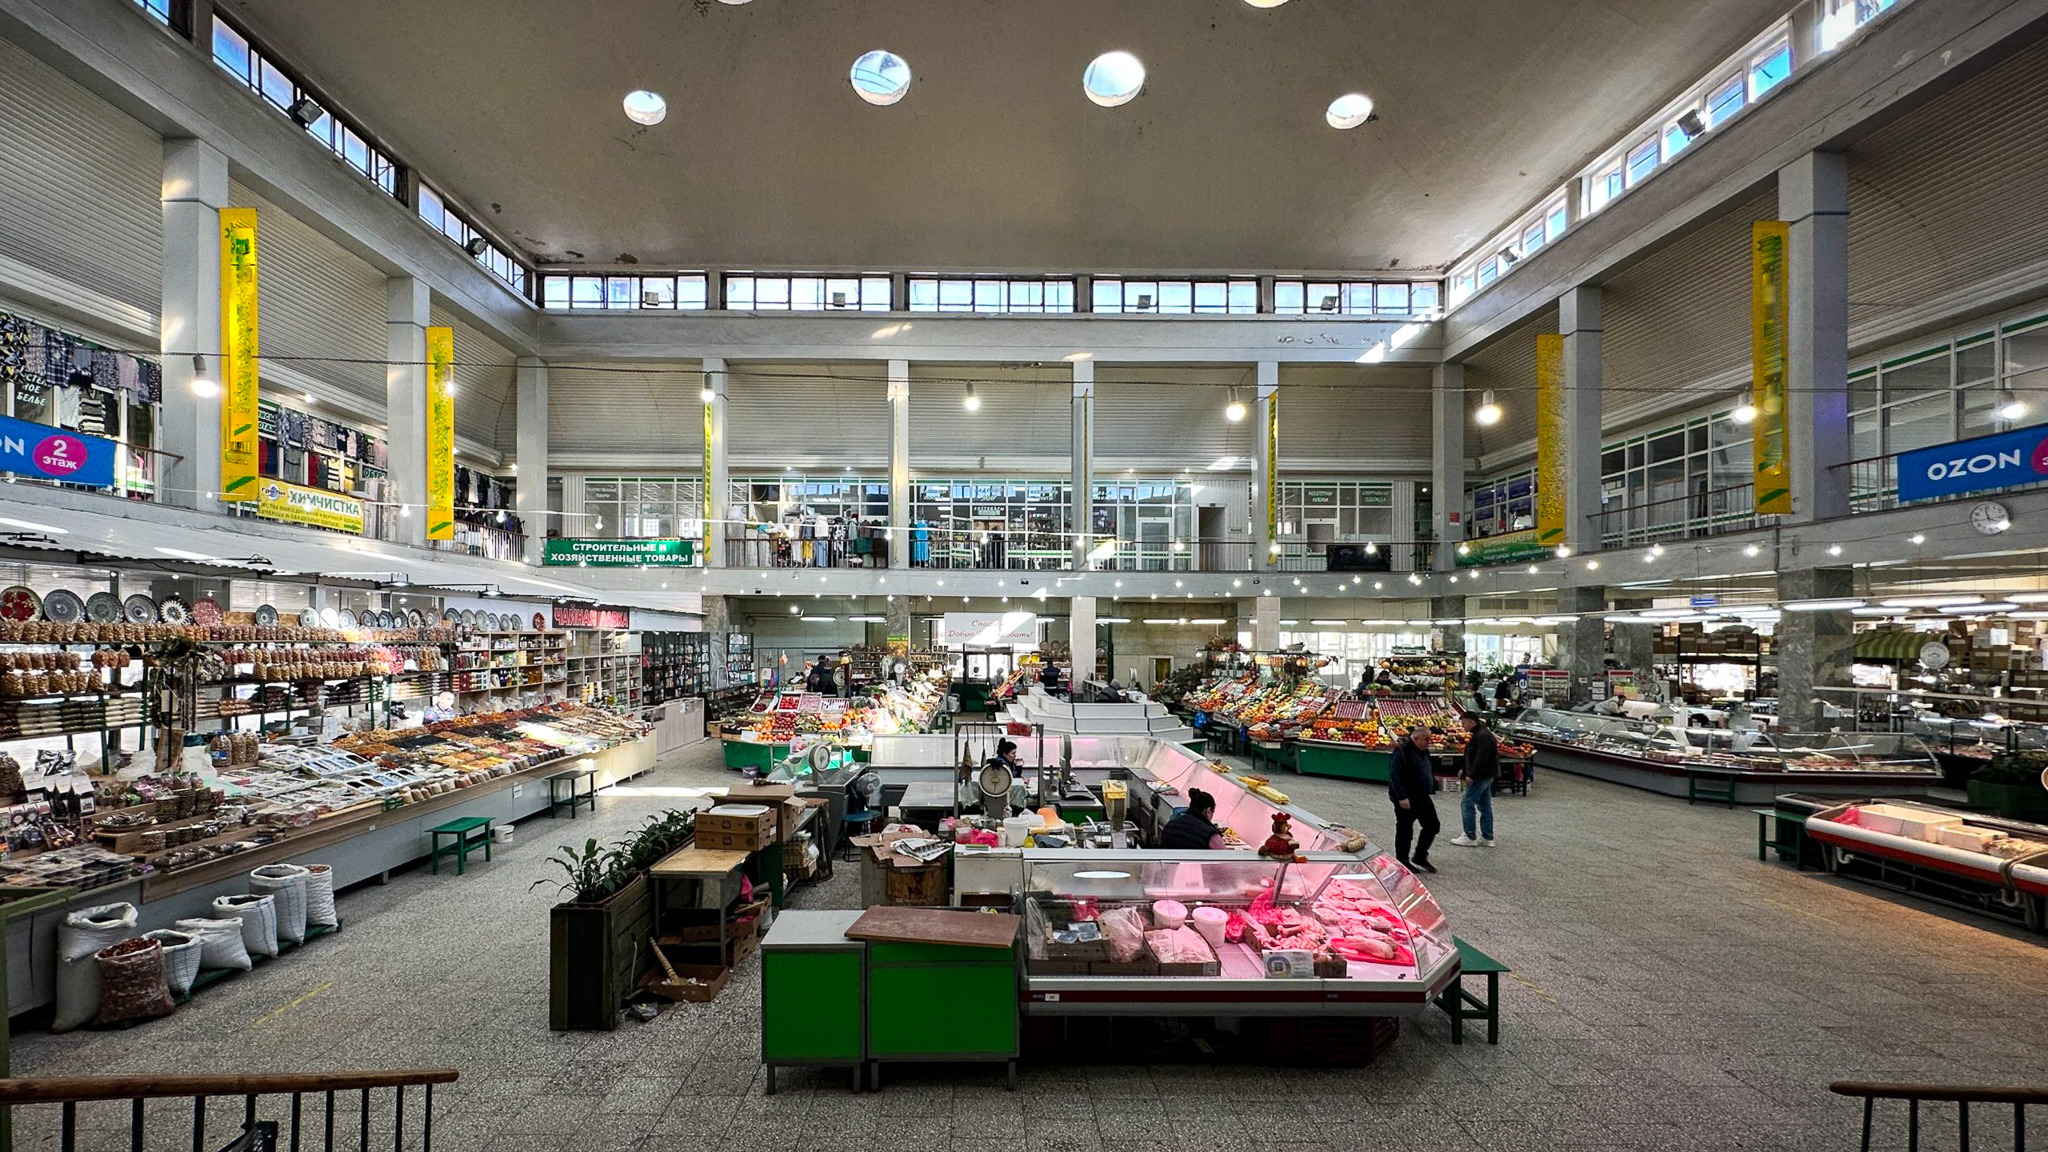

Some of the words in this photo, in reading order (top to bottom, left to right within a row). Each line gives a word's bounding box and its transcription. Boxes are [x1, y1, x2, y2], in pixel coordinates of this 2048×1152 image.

[16, 391, 47, 406] БЕЛЬЕ
[53, 439, 68, 458] 2
[42, 456, 77, 470] этаж
[1927, 449, 2020, 481] OZON
[289, 490, 360, 515] ХИМЧИСТКА
[572, 543, 656, 552] СТРОИТЕЛЬНЫЕ
[658, 543, 667, 551] И
[550, 553, 642, 563] ХОЗЯЙСТВЕННЫЕ
[646, 554, 688, 562] ТОВАРЫ
[554, 605, 597, 627] ЧАЙНАЯ
[600, 609, 629, 628] ЛАВКА
